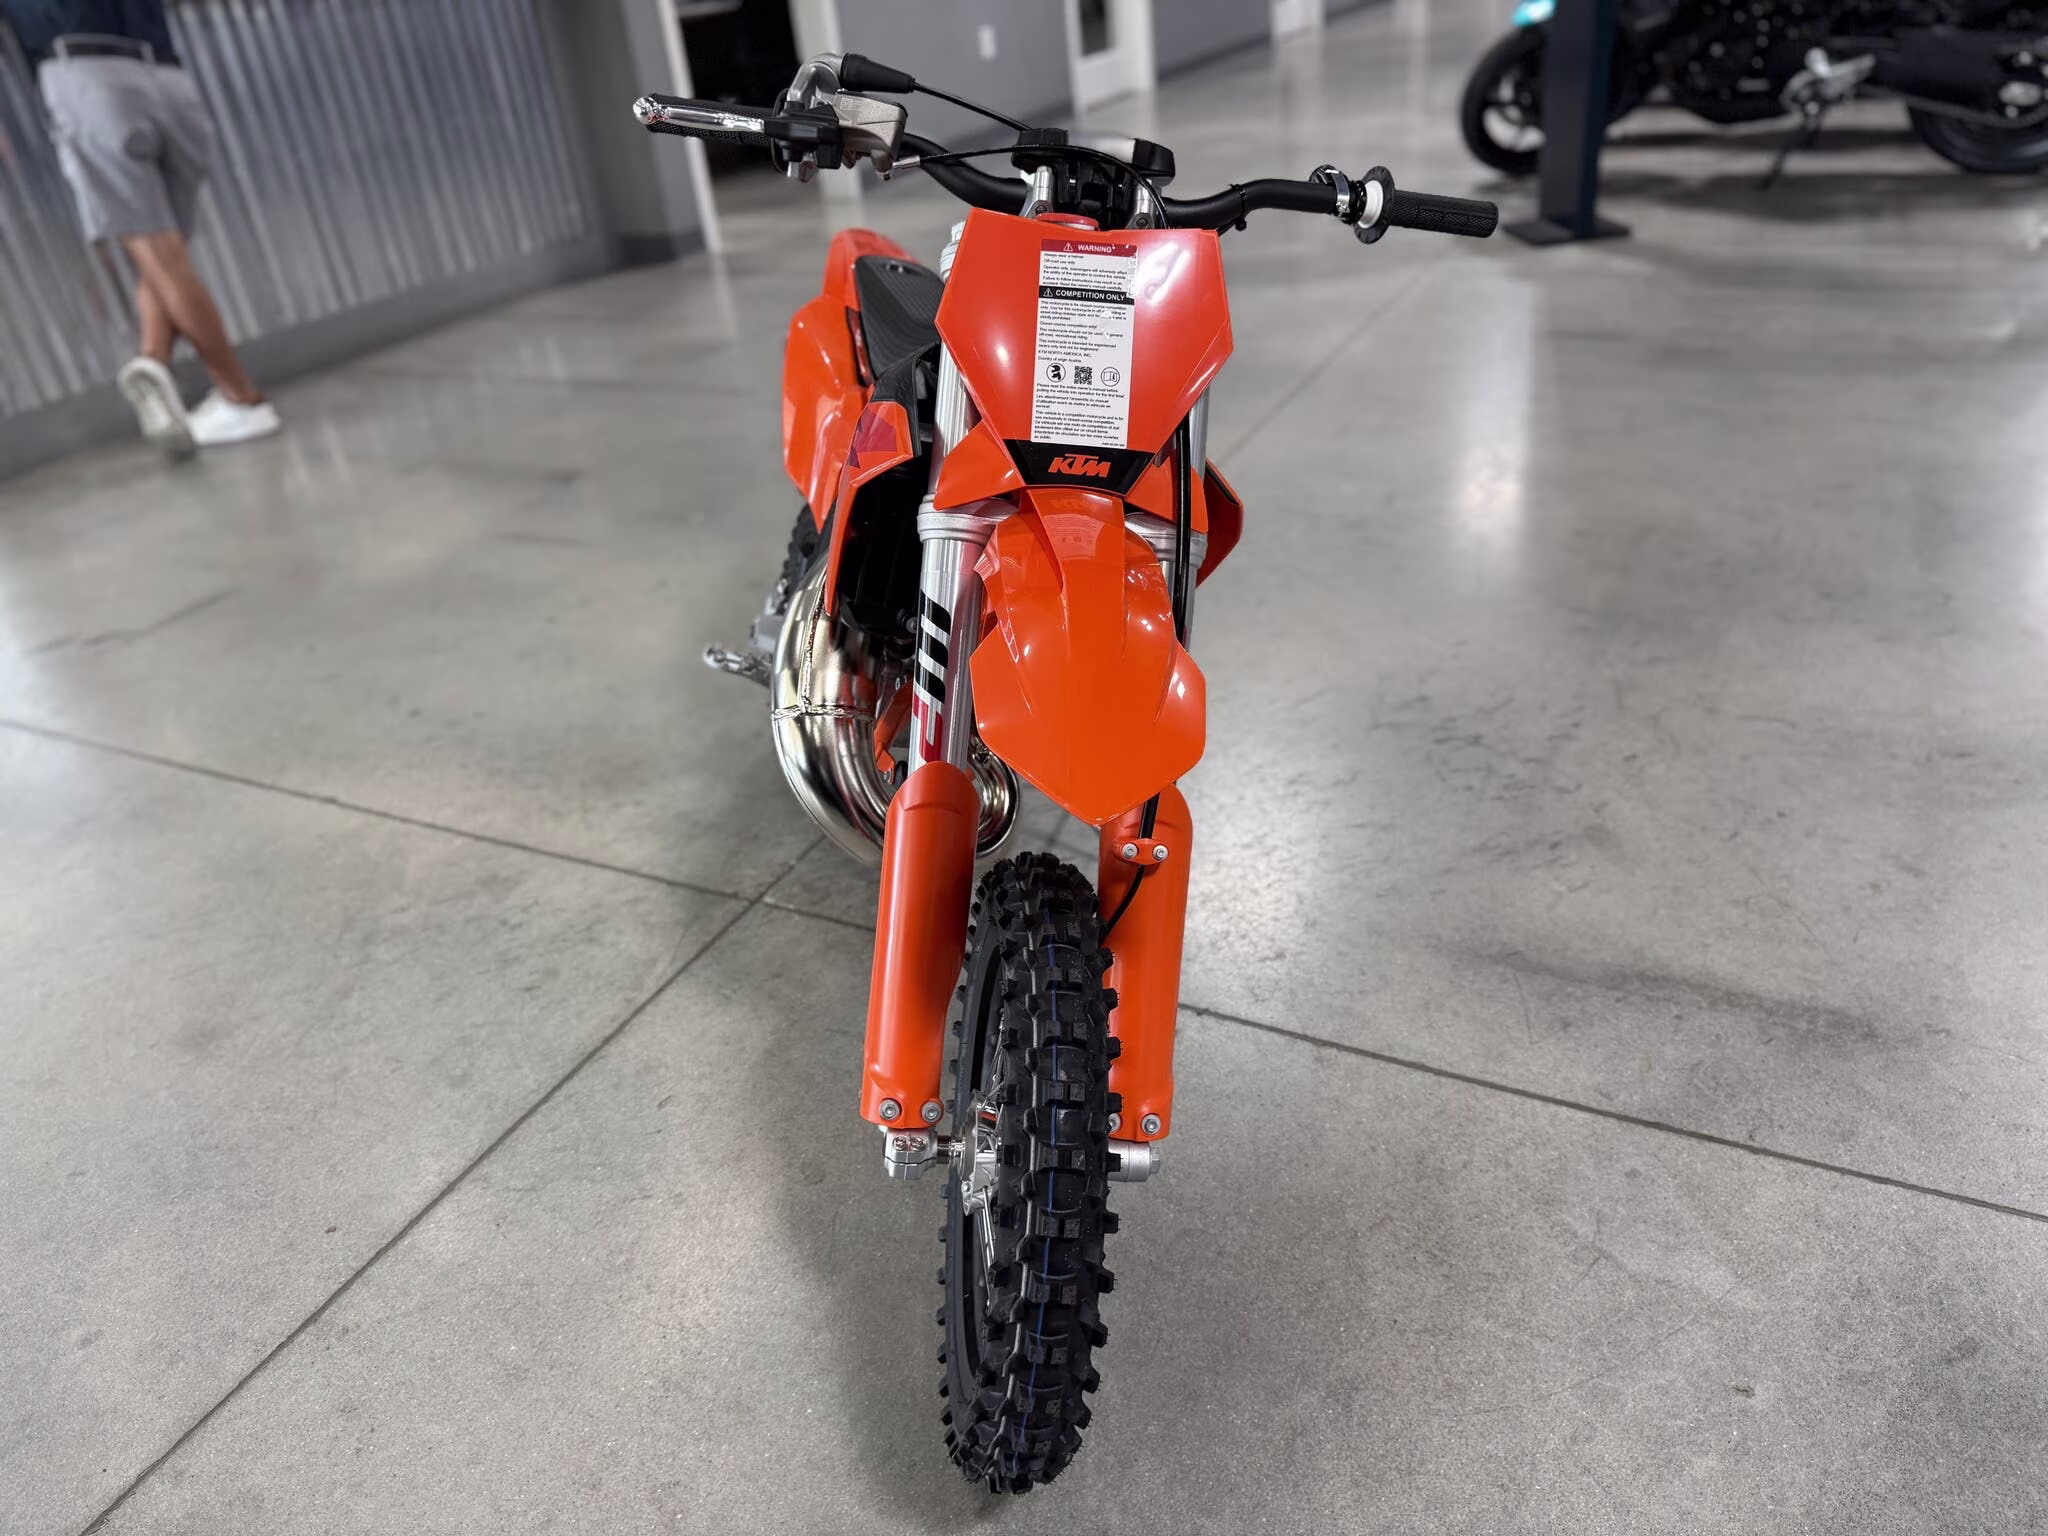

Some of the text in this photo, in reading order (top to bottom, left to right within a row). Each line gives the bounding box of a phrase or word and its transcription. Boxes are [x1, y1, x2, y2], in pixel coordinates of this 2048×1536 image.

[1077, 245, 1112, 253] WARNING
[1056, 290, 1104, 299] COMPETITION
[1048, 453, 1111, 478] KTM
